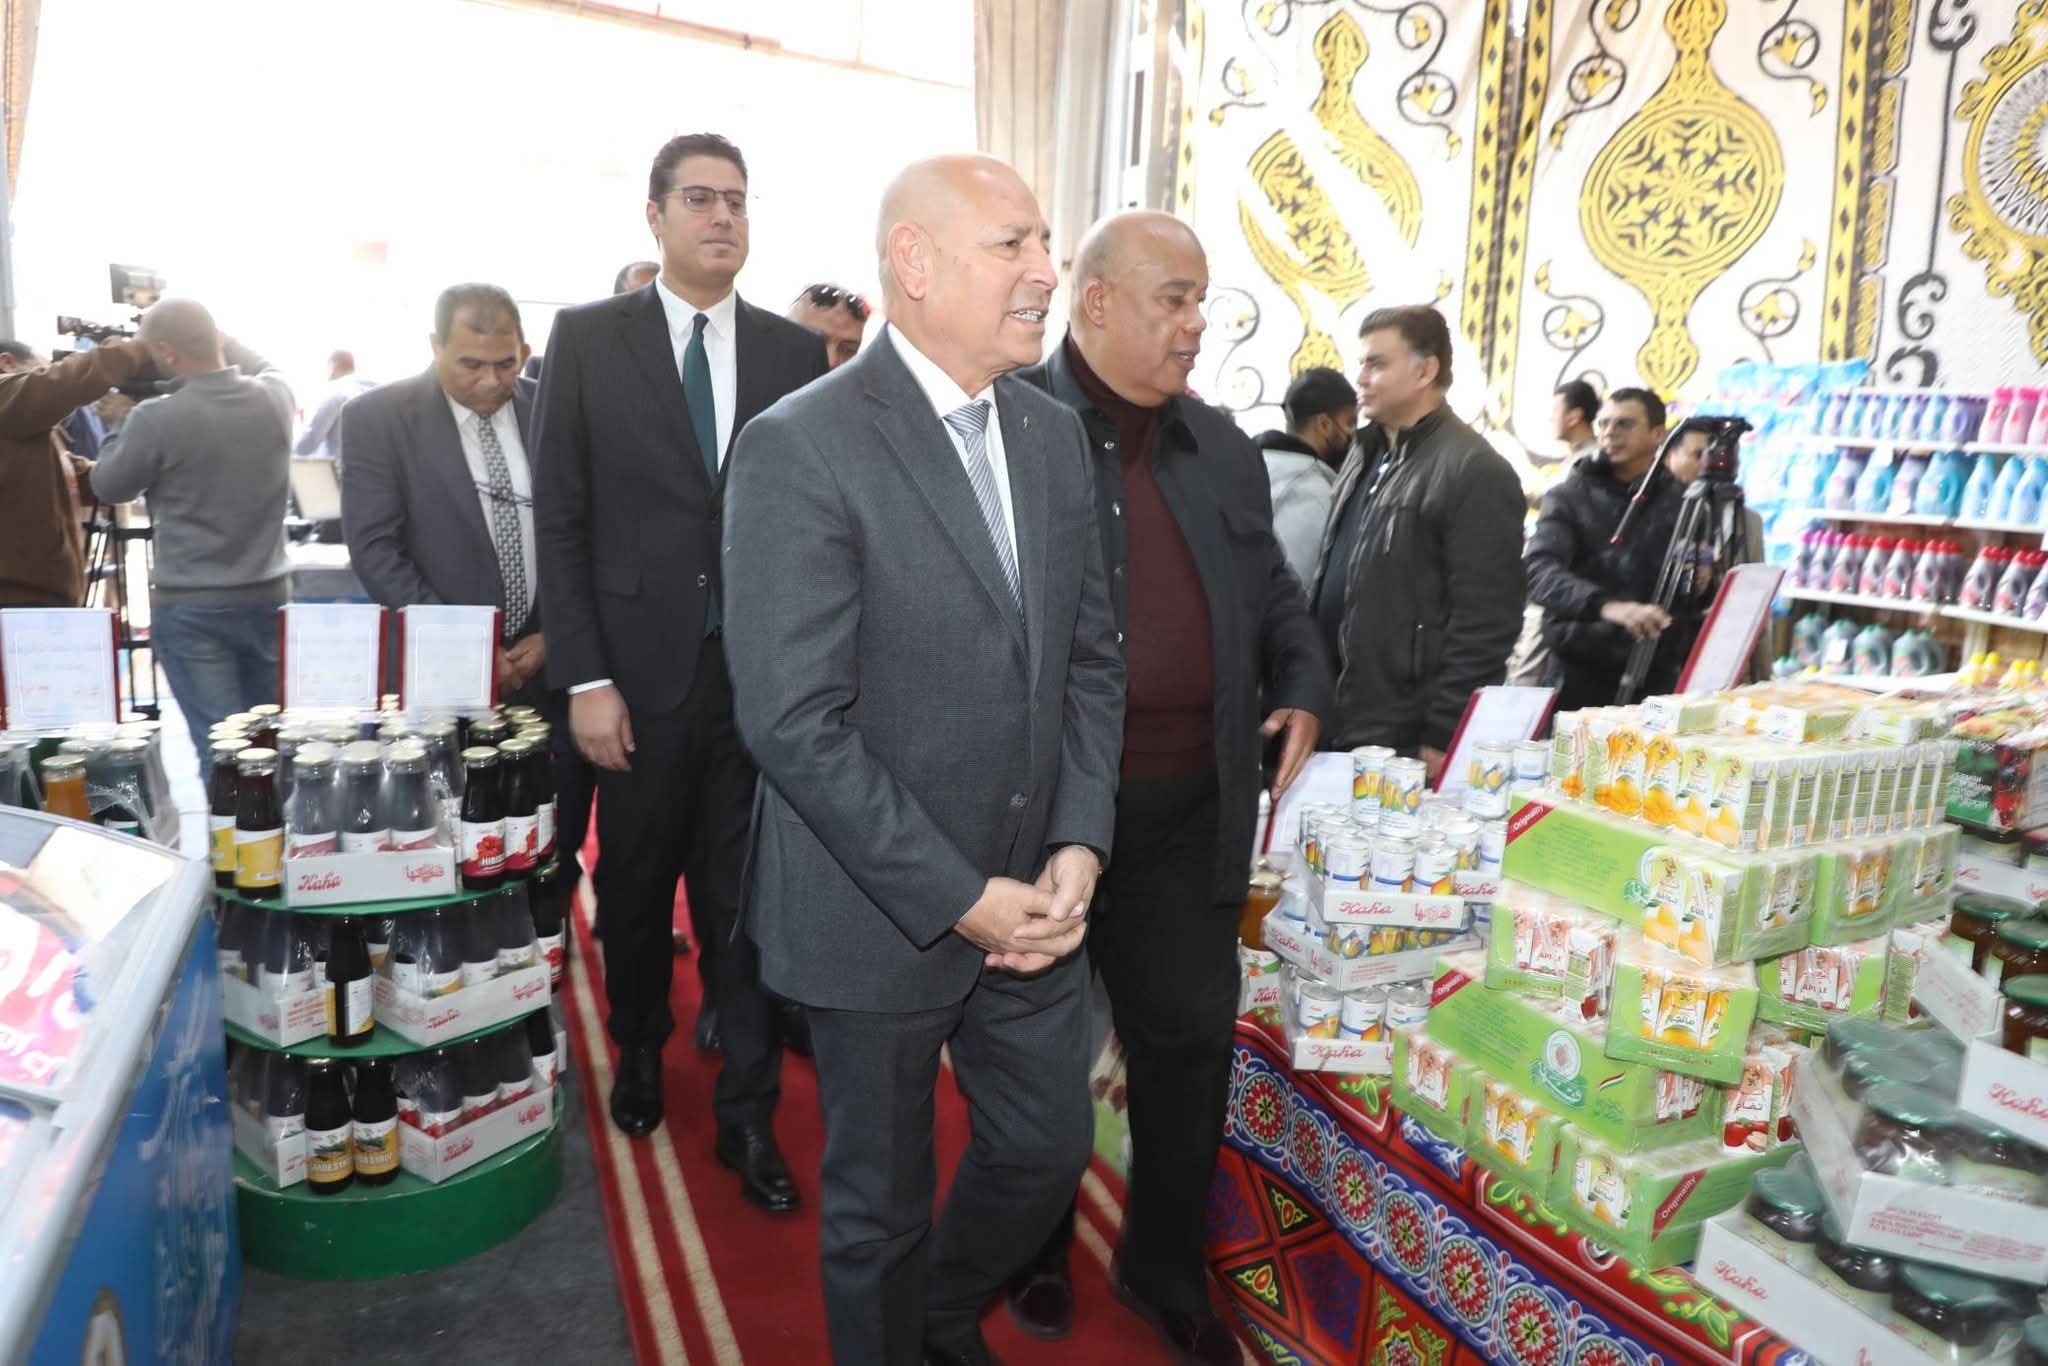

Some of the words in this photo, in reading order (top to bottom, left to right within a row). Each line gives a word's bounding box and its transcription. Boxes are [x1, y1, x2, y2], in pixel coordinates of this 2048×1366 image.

[1338, 901, 1396, 915] Kaha
[1308, 1044, 1367, 1060] Kaha
[1660, 1175, 1697, 1219] Originality
[1714, 1259, 1769, 1300] Kaha
